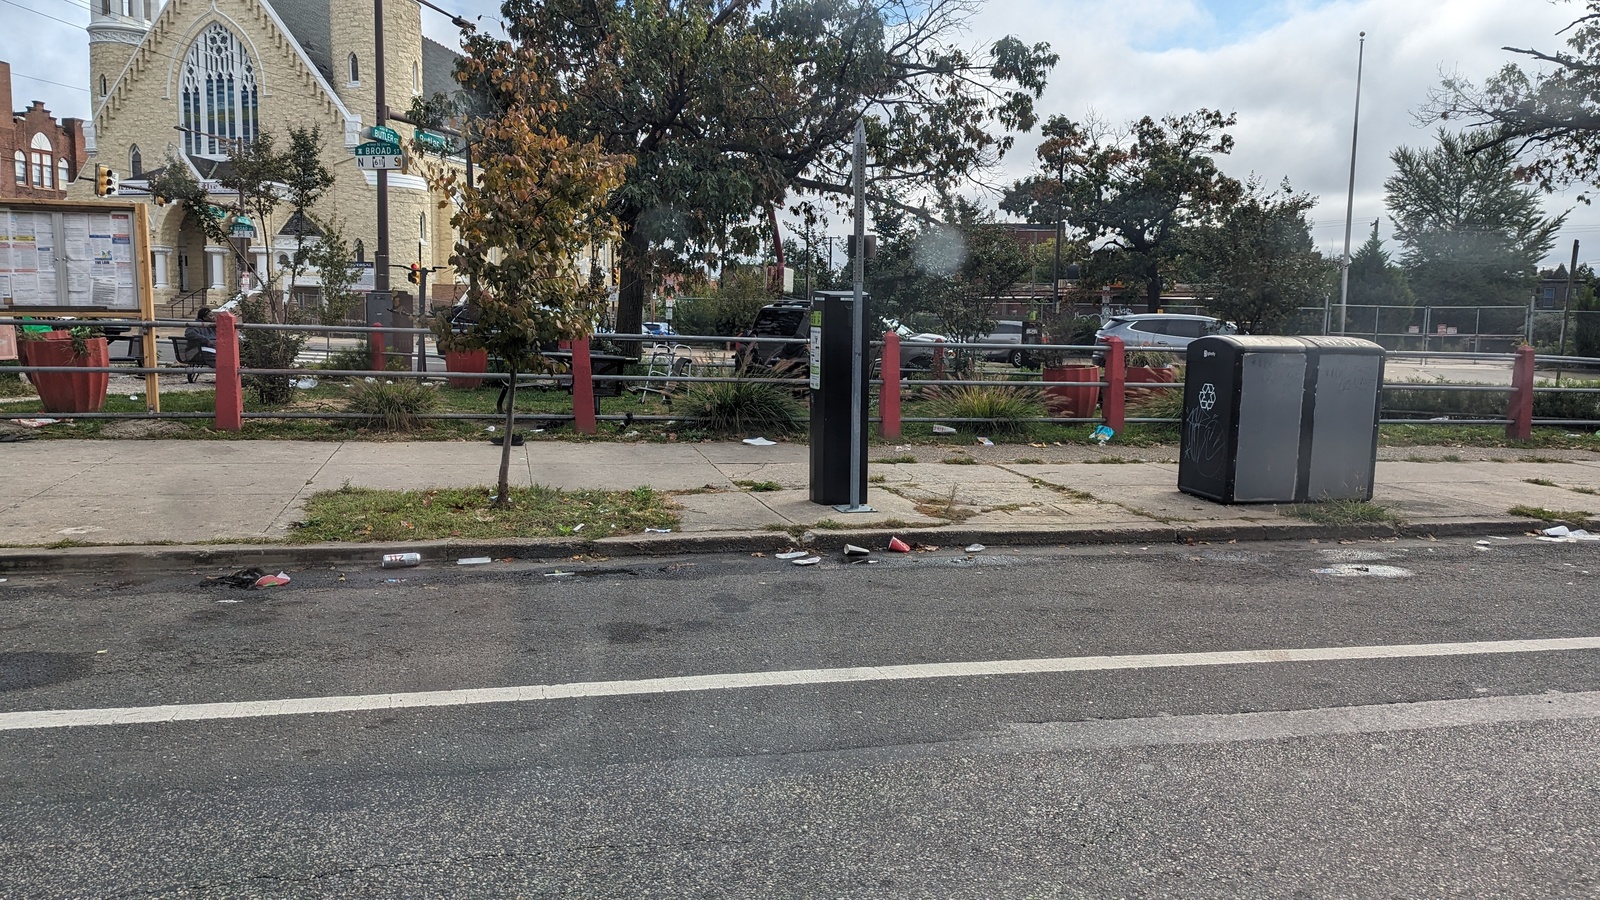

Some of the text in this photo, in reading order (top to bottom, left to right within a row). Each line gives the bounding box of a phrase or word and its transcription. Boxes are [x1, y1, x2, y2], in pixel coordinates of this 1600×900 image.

[374, 129, 394, 142] BUTLER
[365, 147, 392, 155] BROAD
[357, 156, 401, 167] N 611 S
